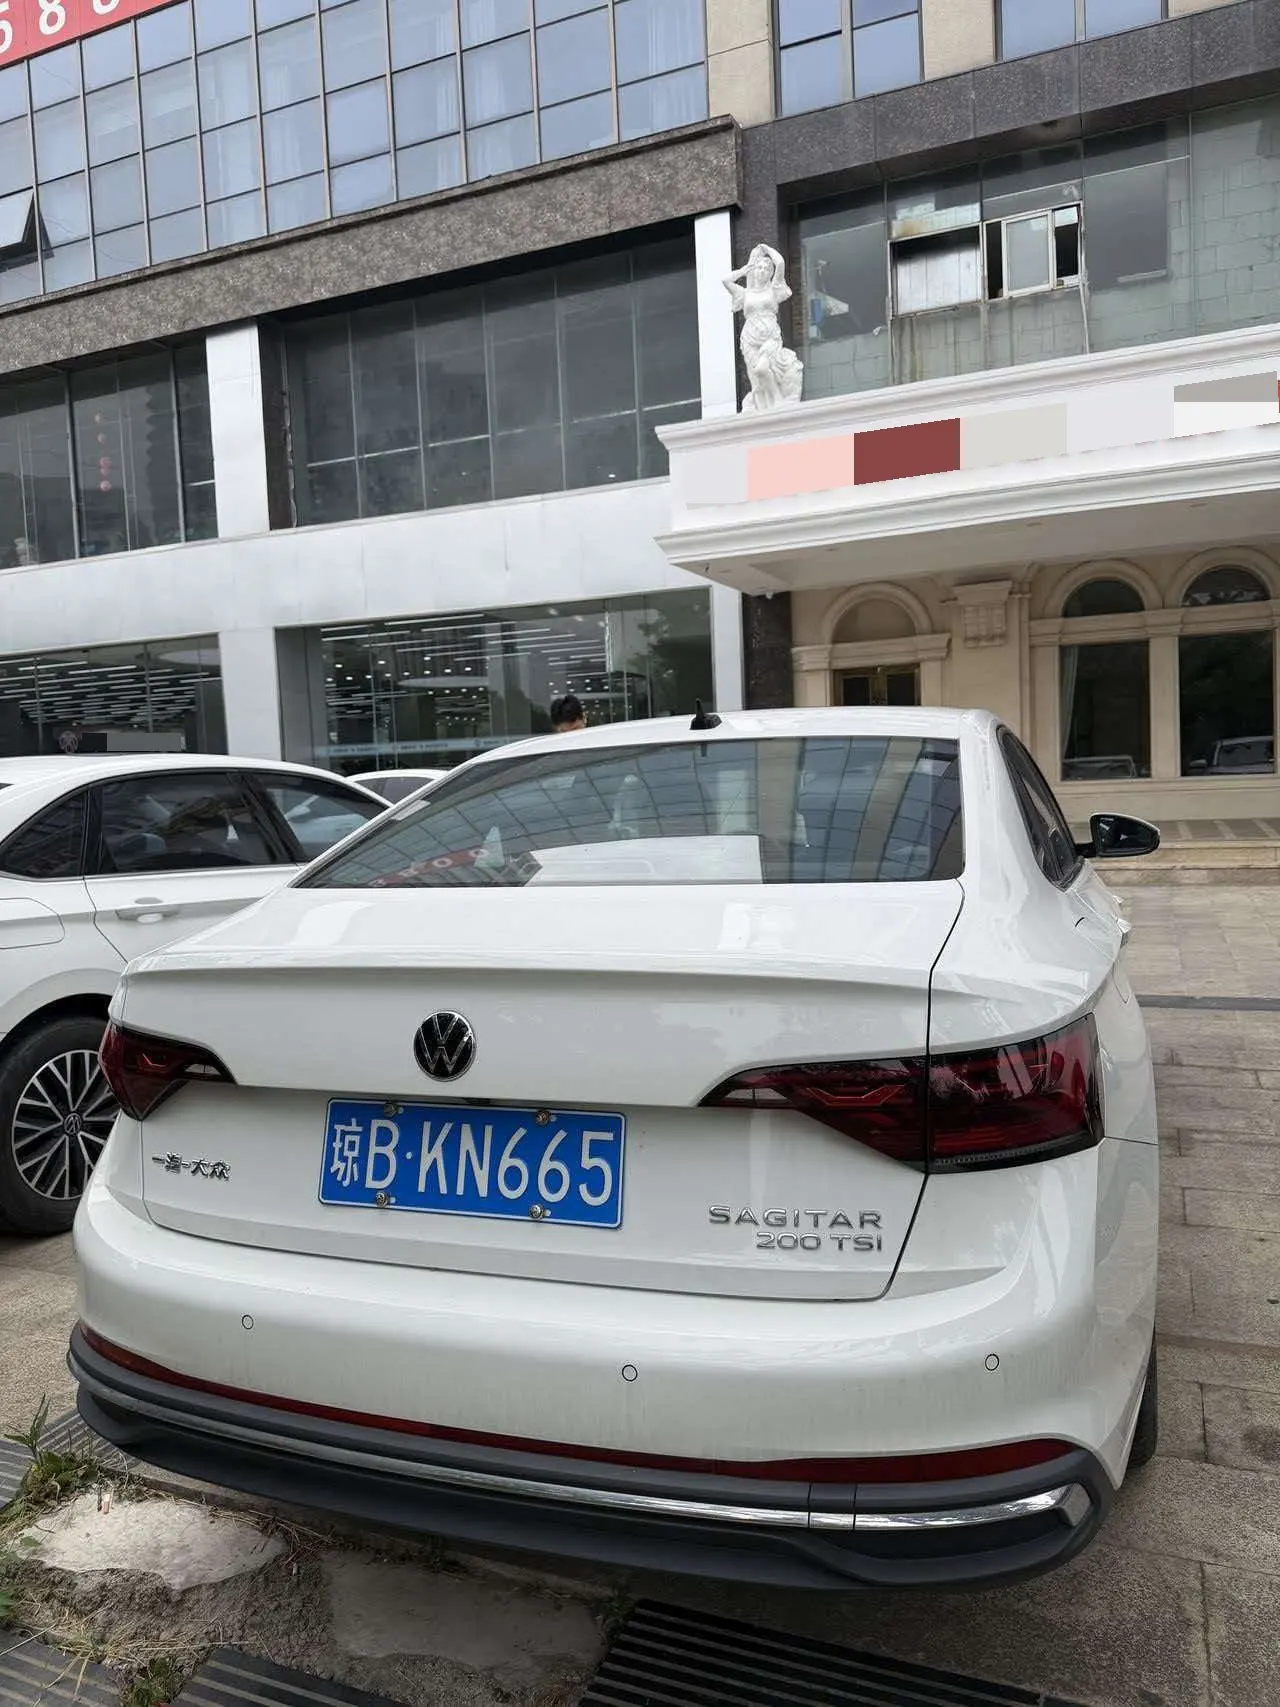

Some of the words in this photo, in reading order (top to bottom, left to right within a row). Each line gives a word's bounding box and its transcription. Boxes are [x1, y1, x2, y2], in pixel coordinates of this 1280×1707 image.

[416, 1011, 474, 1078] VW
[709, 1205, 882, 1230] SAGITAR
[756, 1232, 822, 1251] 200
[830, 1233, 882, 1252] TSI
